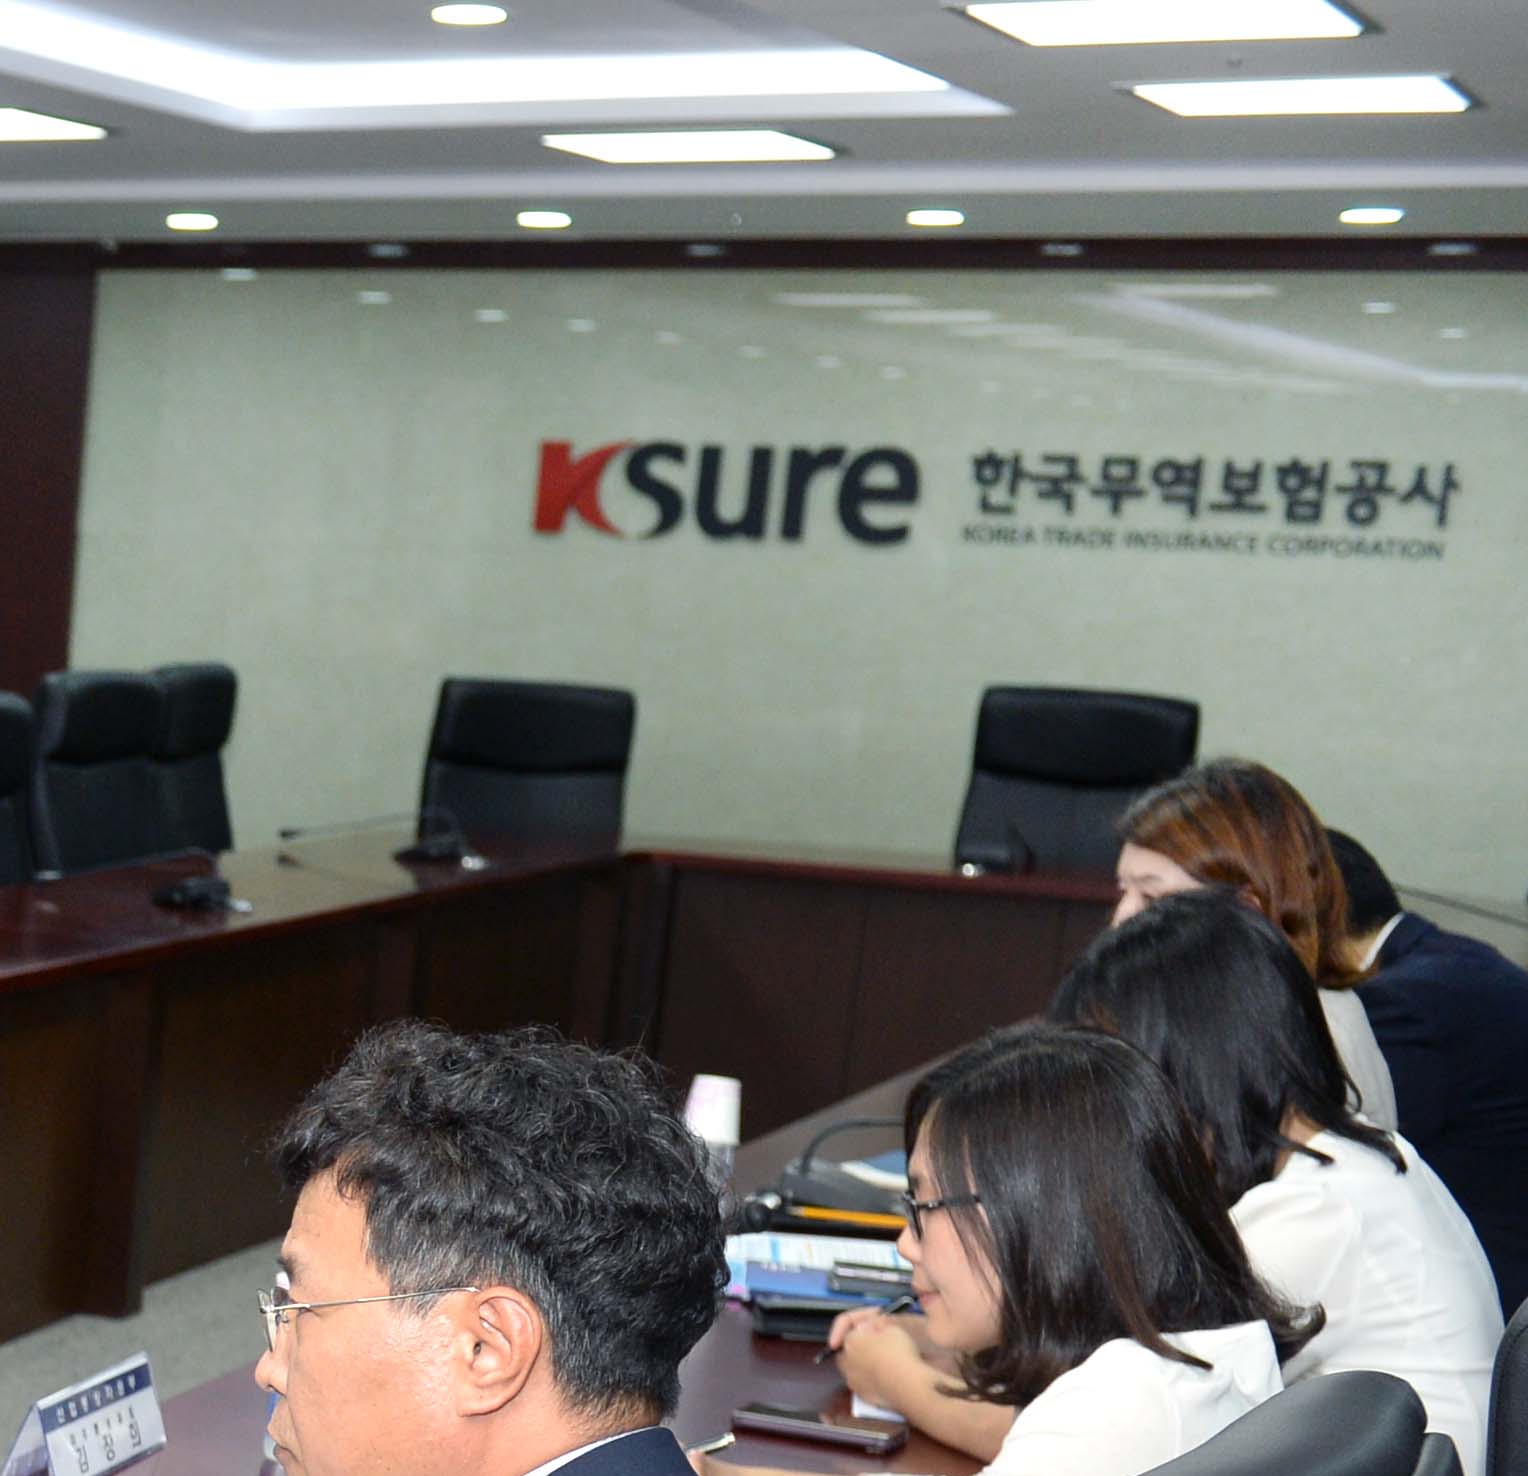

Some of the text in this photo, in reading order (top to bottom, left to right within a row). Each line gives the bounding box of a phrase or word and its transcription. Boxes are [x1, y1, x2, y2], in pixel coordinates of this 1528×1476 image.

[972, 450, 1460, 530] 한국무역보험공사
[963, 525, 1446, 561] KOREA TRADE INSURANCE CORPORATION
